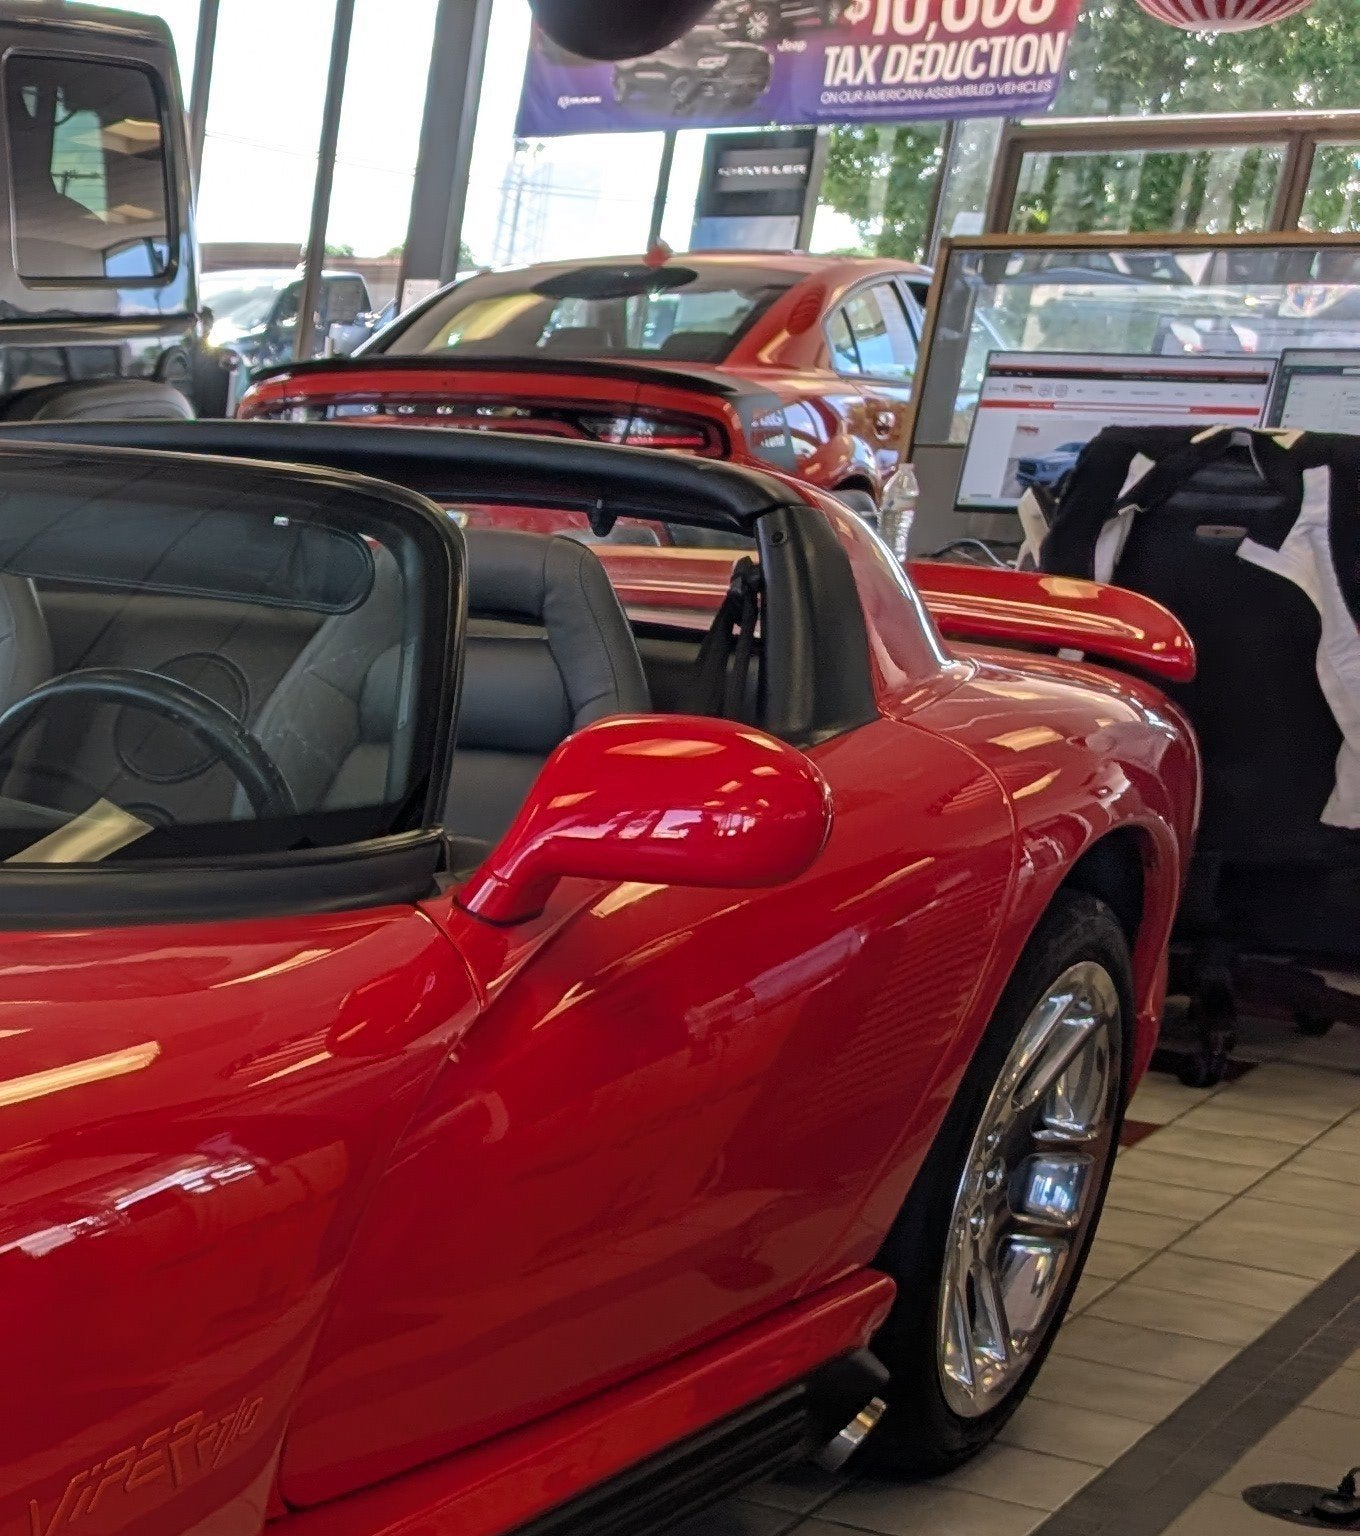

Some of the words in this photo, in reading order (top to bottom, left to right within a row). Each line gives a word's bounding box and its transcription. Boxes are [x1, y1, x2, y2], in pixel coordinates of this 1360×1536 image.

[823, 44, 881, 87] TAX
[881, 30, 1068, 84] DEDUCTION
[996, 79, 1053, 95] VEHICLES
